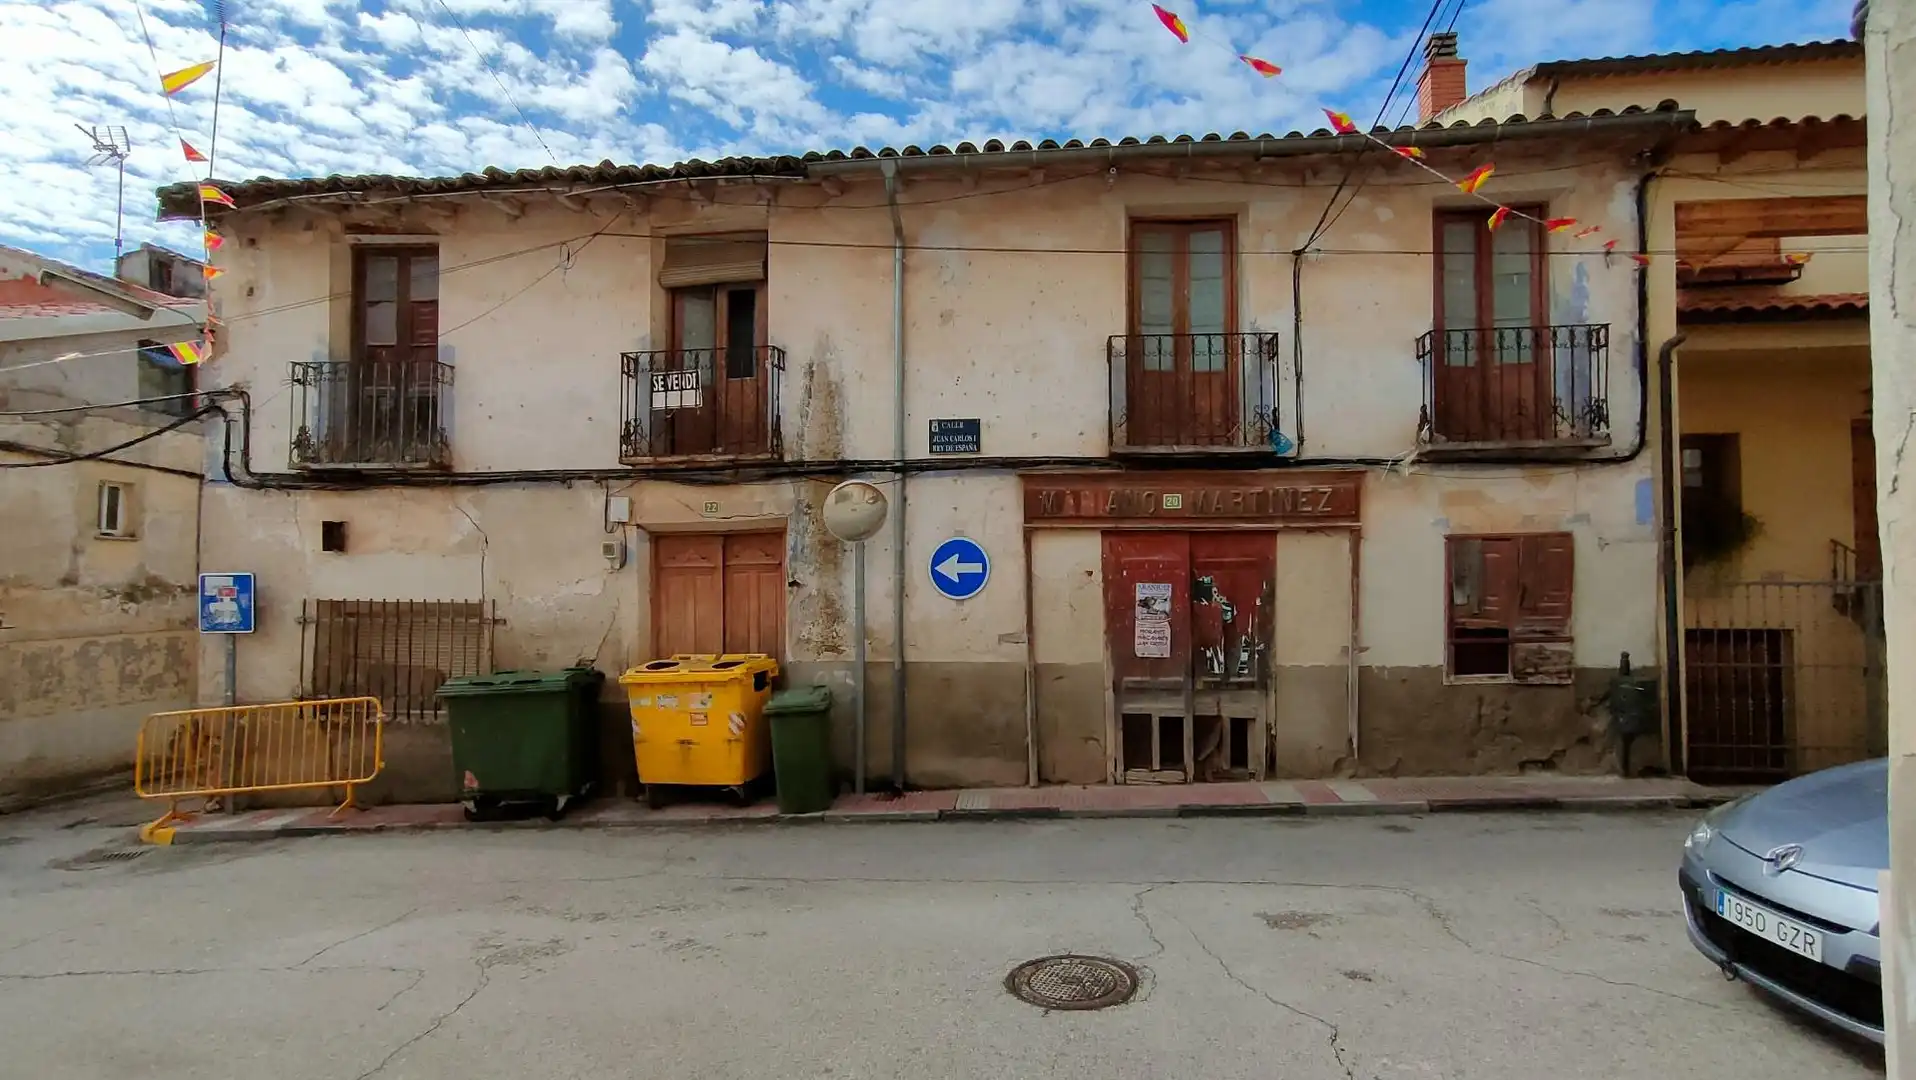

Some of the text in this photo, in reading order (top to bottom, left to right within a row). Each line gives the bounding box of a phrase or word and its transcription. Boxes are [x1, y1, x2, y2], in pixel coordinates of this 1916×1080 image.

[652, 375, 665, 391] SE
[949, 434, 973, 442] CARLOS
[955, 443, 978, 451] ESPAÑA
[1166, 497, 1179, 506] 20
[706, 503, 717, 512] 22
[1727, 898, 1816, 956] 1950 GZR
